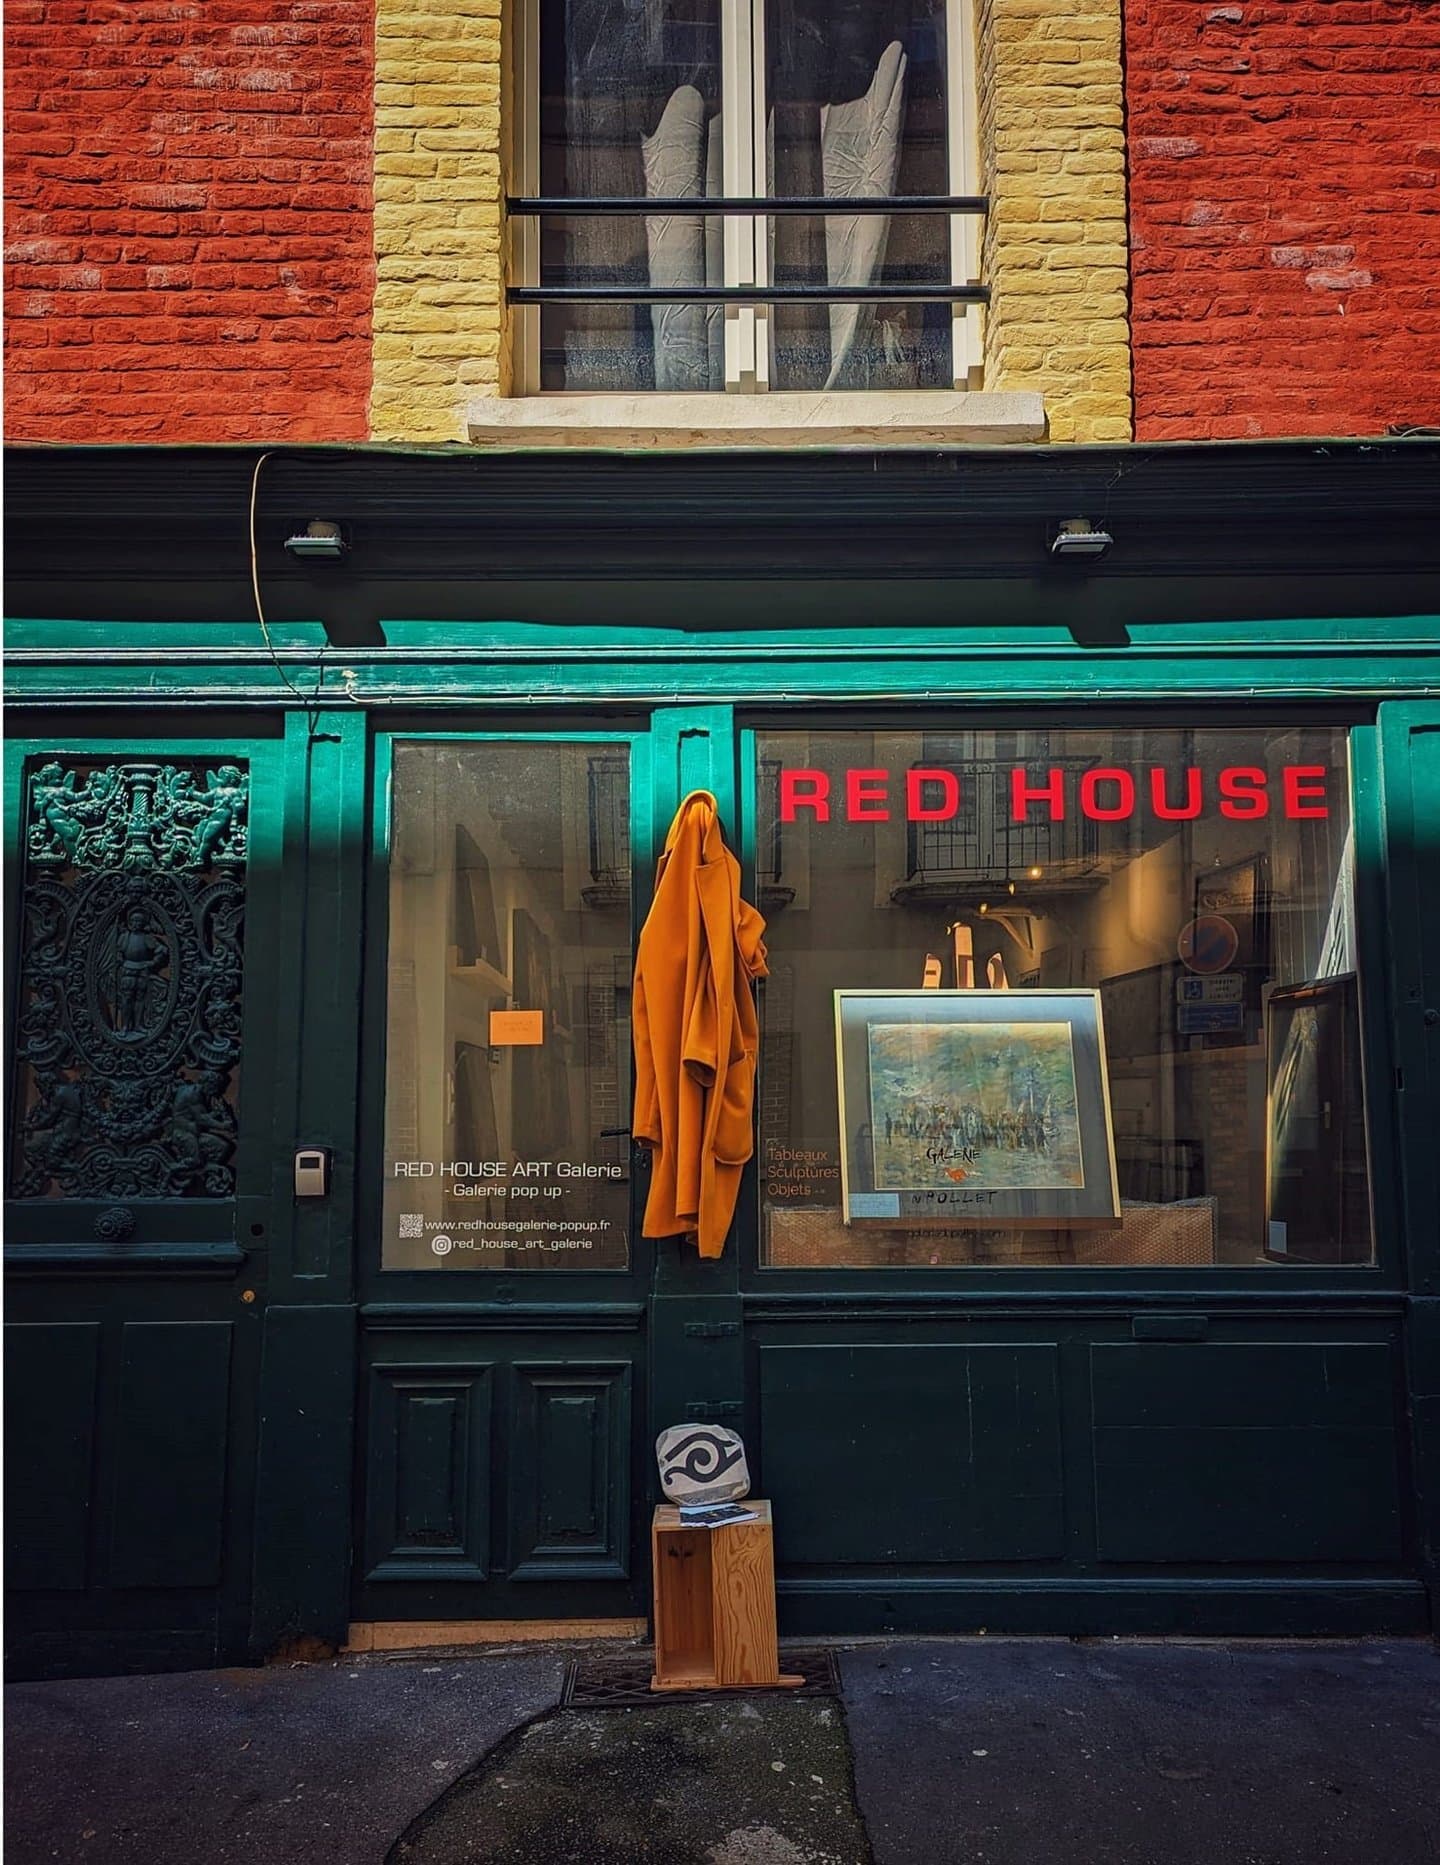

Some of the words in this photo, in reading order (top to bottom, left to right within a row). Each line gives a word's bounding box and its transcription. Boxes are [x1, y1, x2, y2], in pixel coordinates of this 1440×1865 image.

[780, 768, 959, 822] RED
[1012, 766, 1329, 822] HOUSE
[768, 1148, 828, 1161] Tableaux
[394, 1162, 434, 1177] RED
[440, 1162, 507, 1177] HOUSE
[512, 1162, 552, 1177] ART
[557, 1162, 622, 1178] Galerie
[767, 1164, 840, 1181] Sculptures
[453, 1184, 506, 1197] Galerie
[511, 1186, 539, 1199] pop
[543, 1186, 562, 1199] up
[767, 1182, 812, 1198] Objets
[927, 1190, 998, 1205] POLLET
[425, 1220, 611, 1232] www.redhousegalerie-popup.fr
[453, 1238, 593, 1251] red_house_art_galerie
